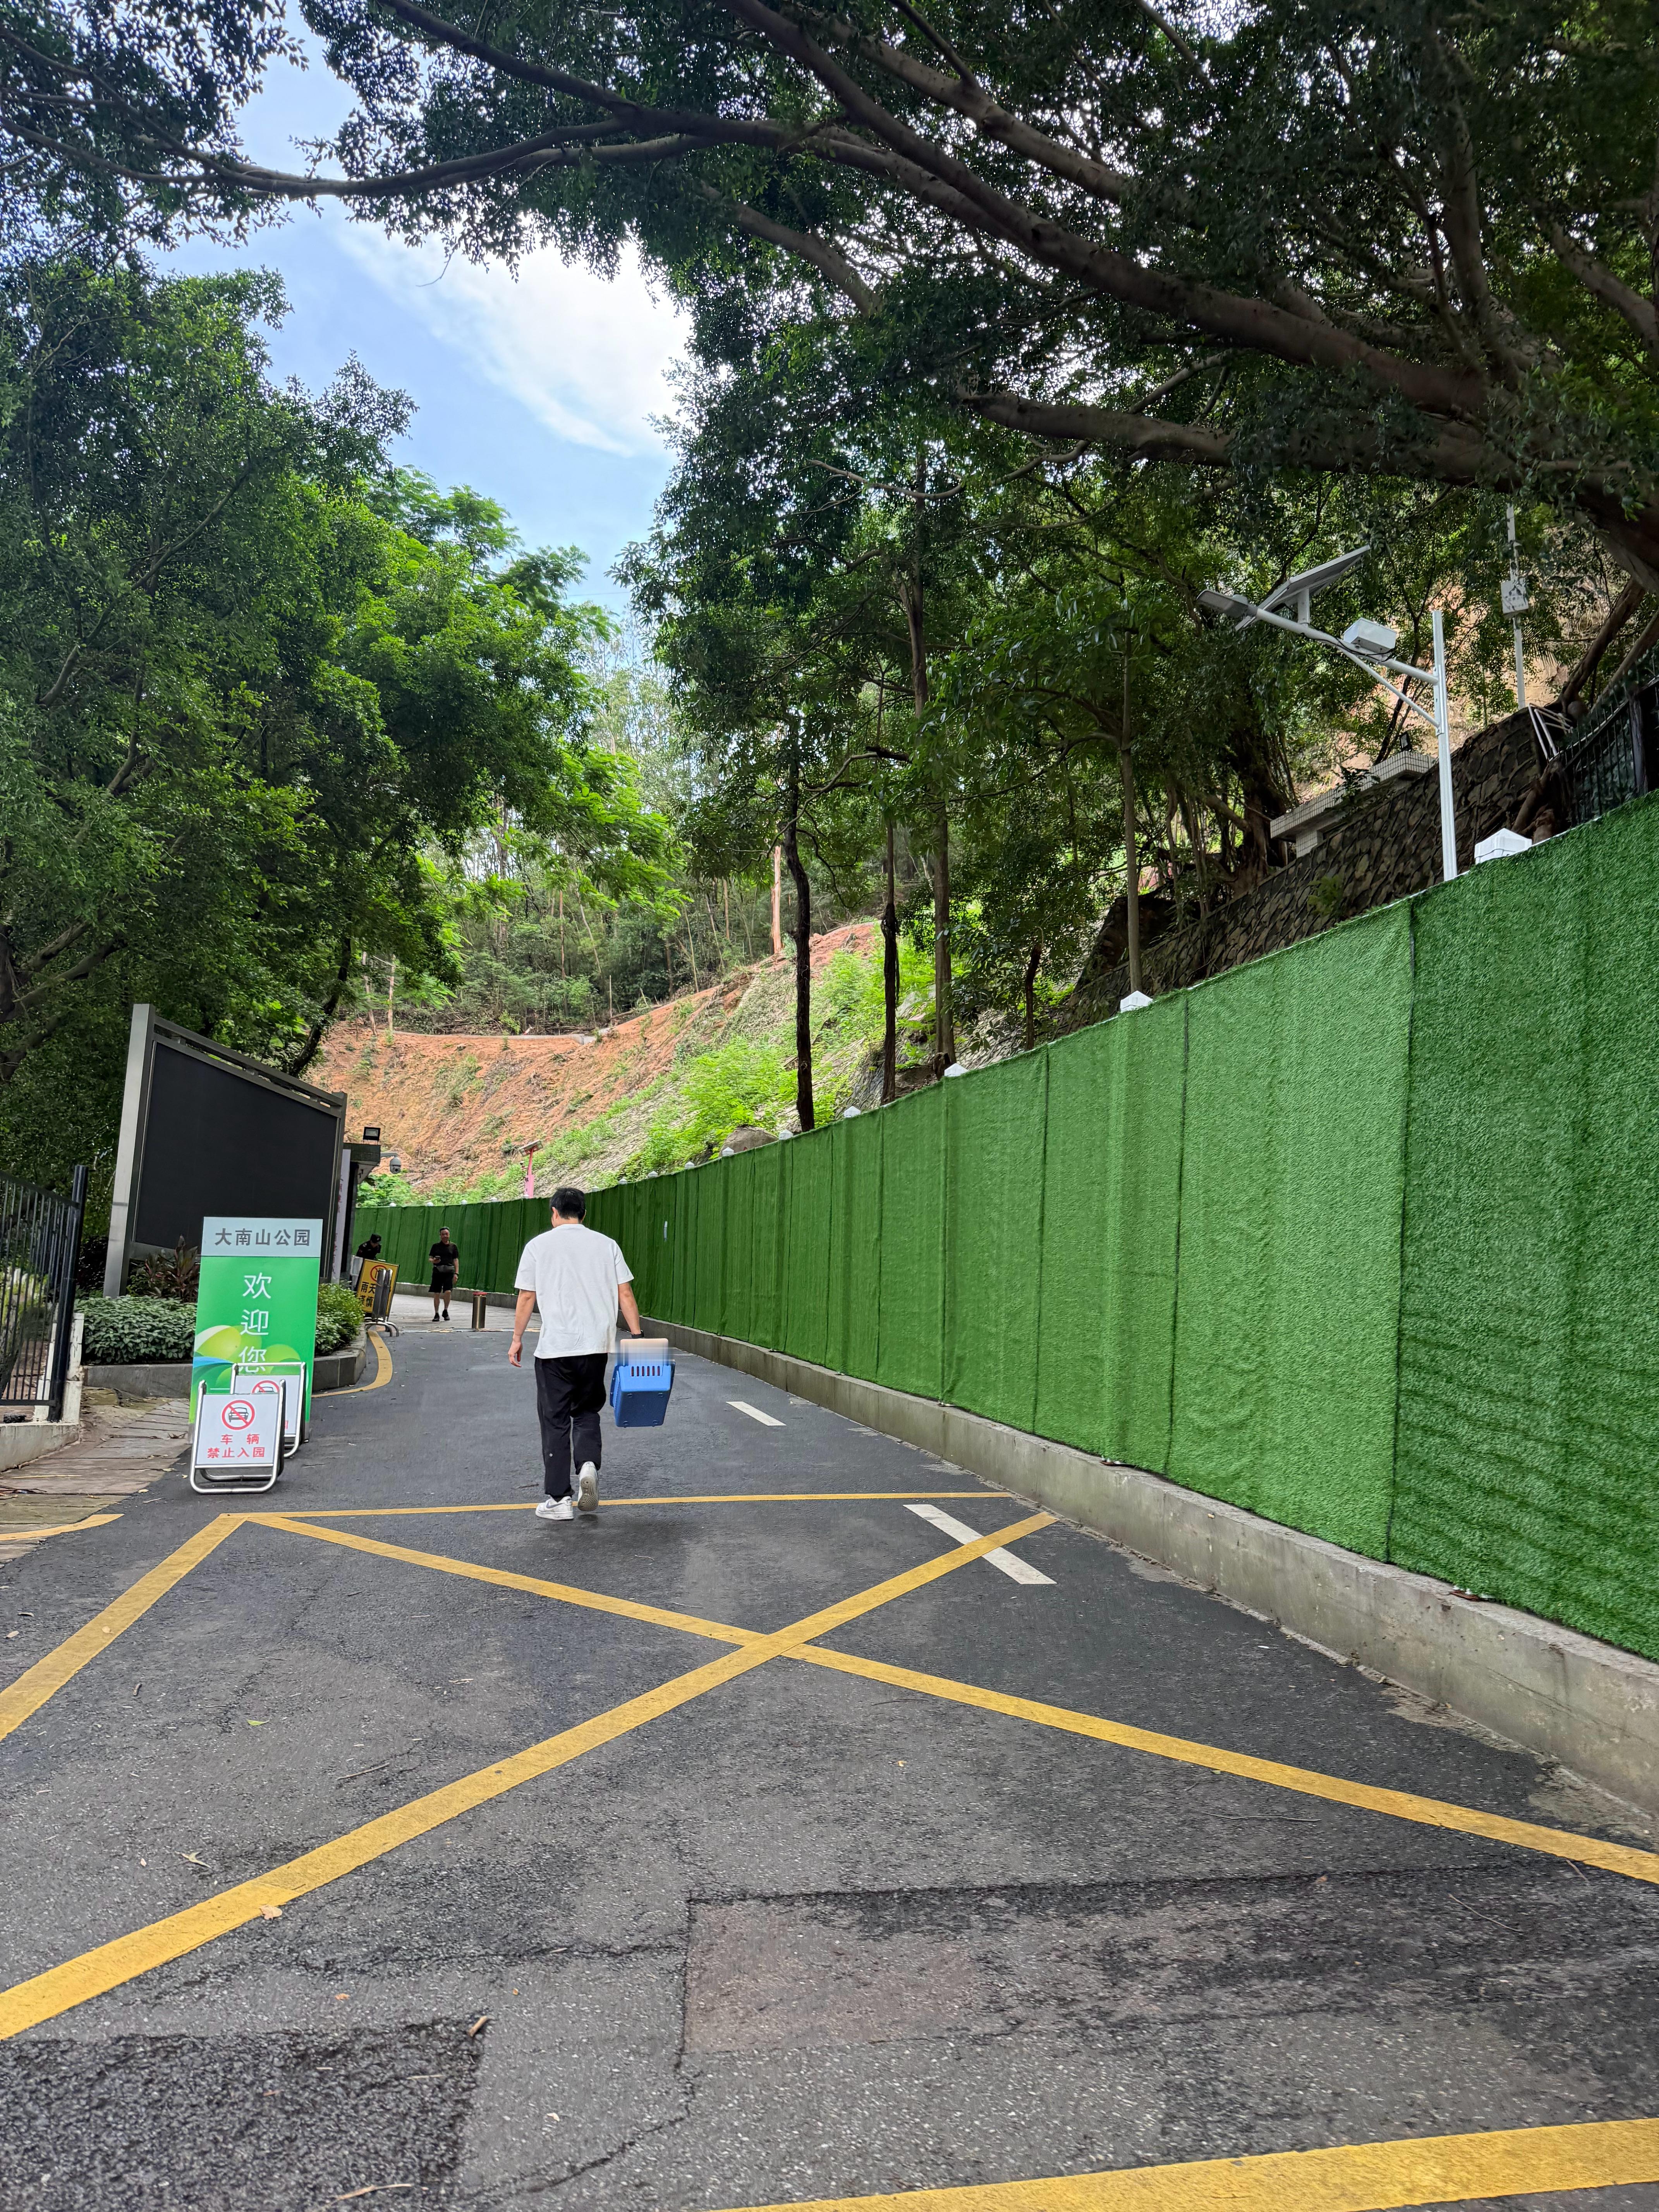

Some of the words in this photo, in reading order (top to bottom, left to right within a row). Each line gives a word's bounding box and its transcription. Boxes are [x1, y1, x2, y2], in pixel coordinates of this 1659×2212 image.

[215, 1228, 310, 1246] 大南山公园
[238, 1272, 272, 1373] 欢迎您
[207, 1447, 265, 1458] 禁止入园
